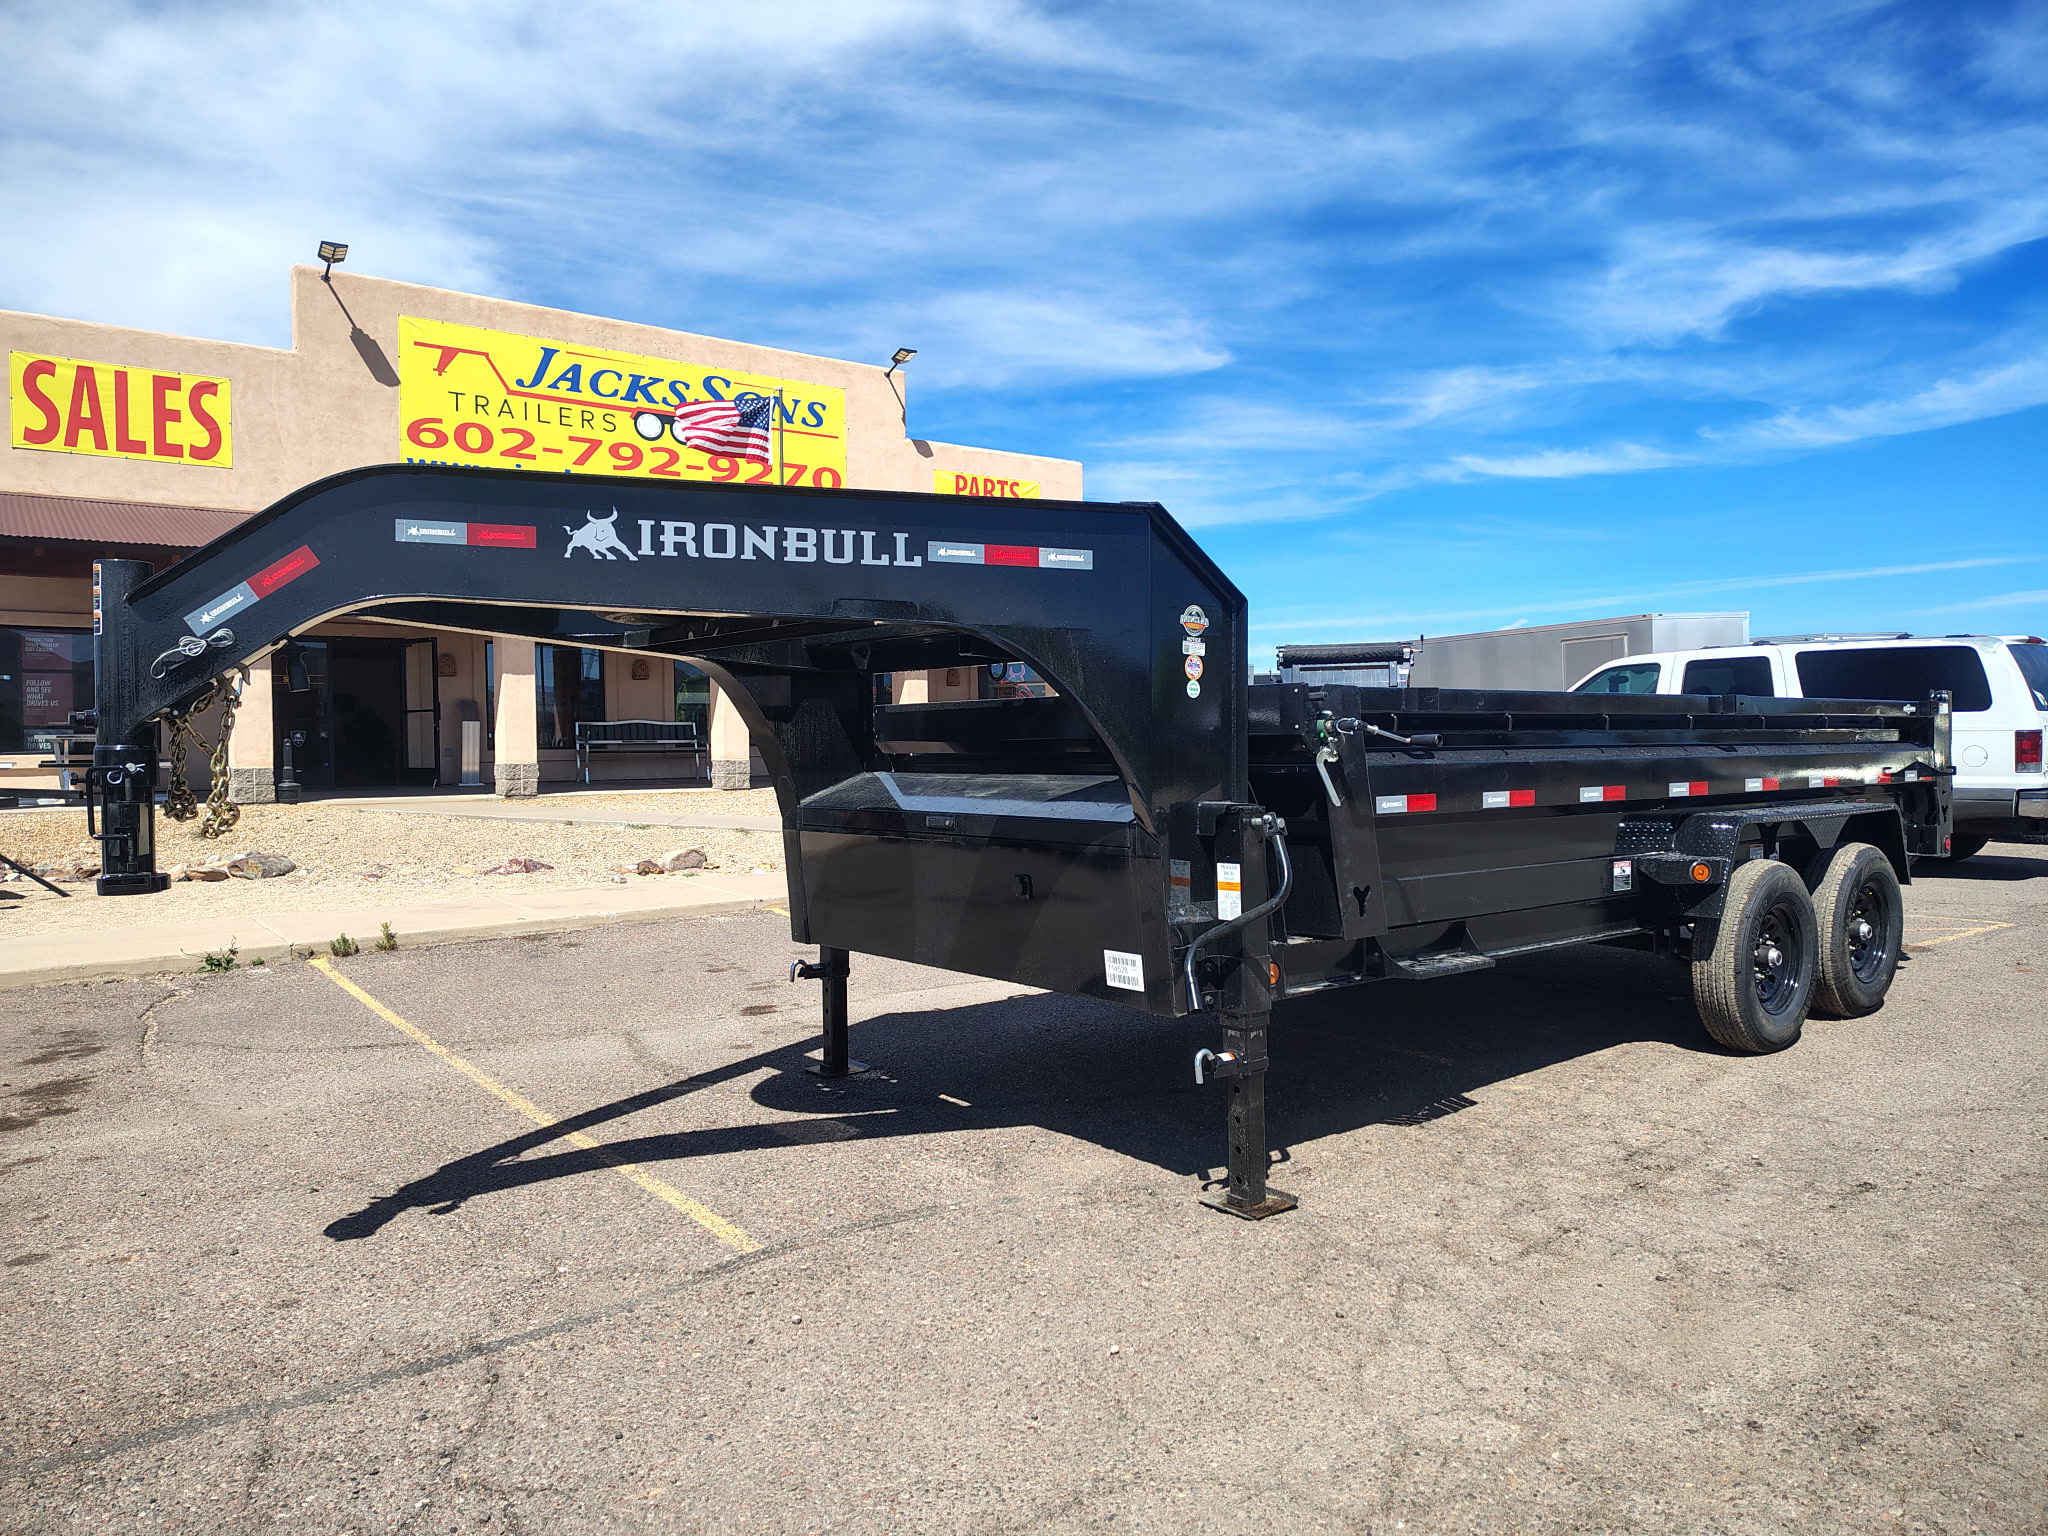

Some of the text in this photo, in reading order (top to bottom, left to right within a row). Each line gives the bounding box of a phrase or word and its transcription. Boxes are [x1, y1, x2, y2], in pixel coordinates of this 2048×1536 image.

[23, 359, 222, 461] SALES
[448, 390, 618, 433] TRAILERS
[405, 416, 842, 489] 602-792-9270
[955, 474, 1020, 499] PARTS
[637, 519, 922, 567] IRONBULL
